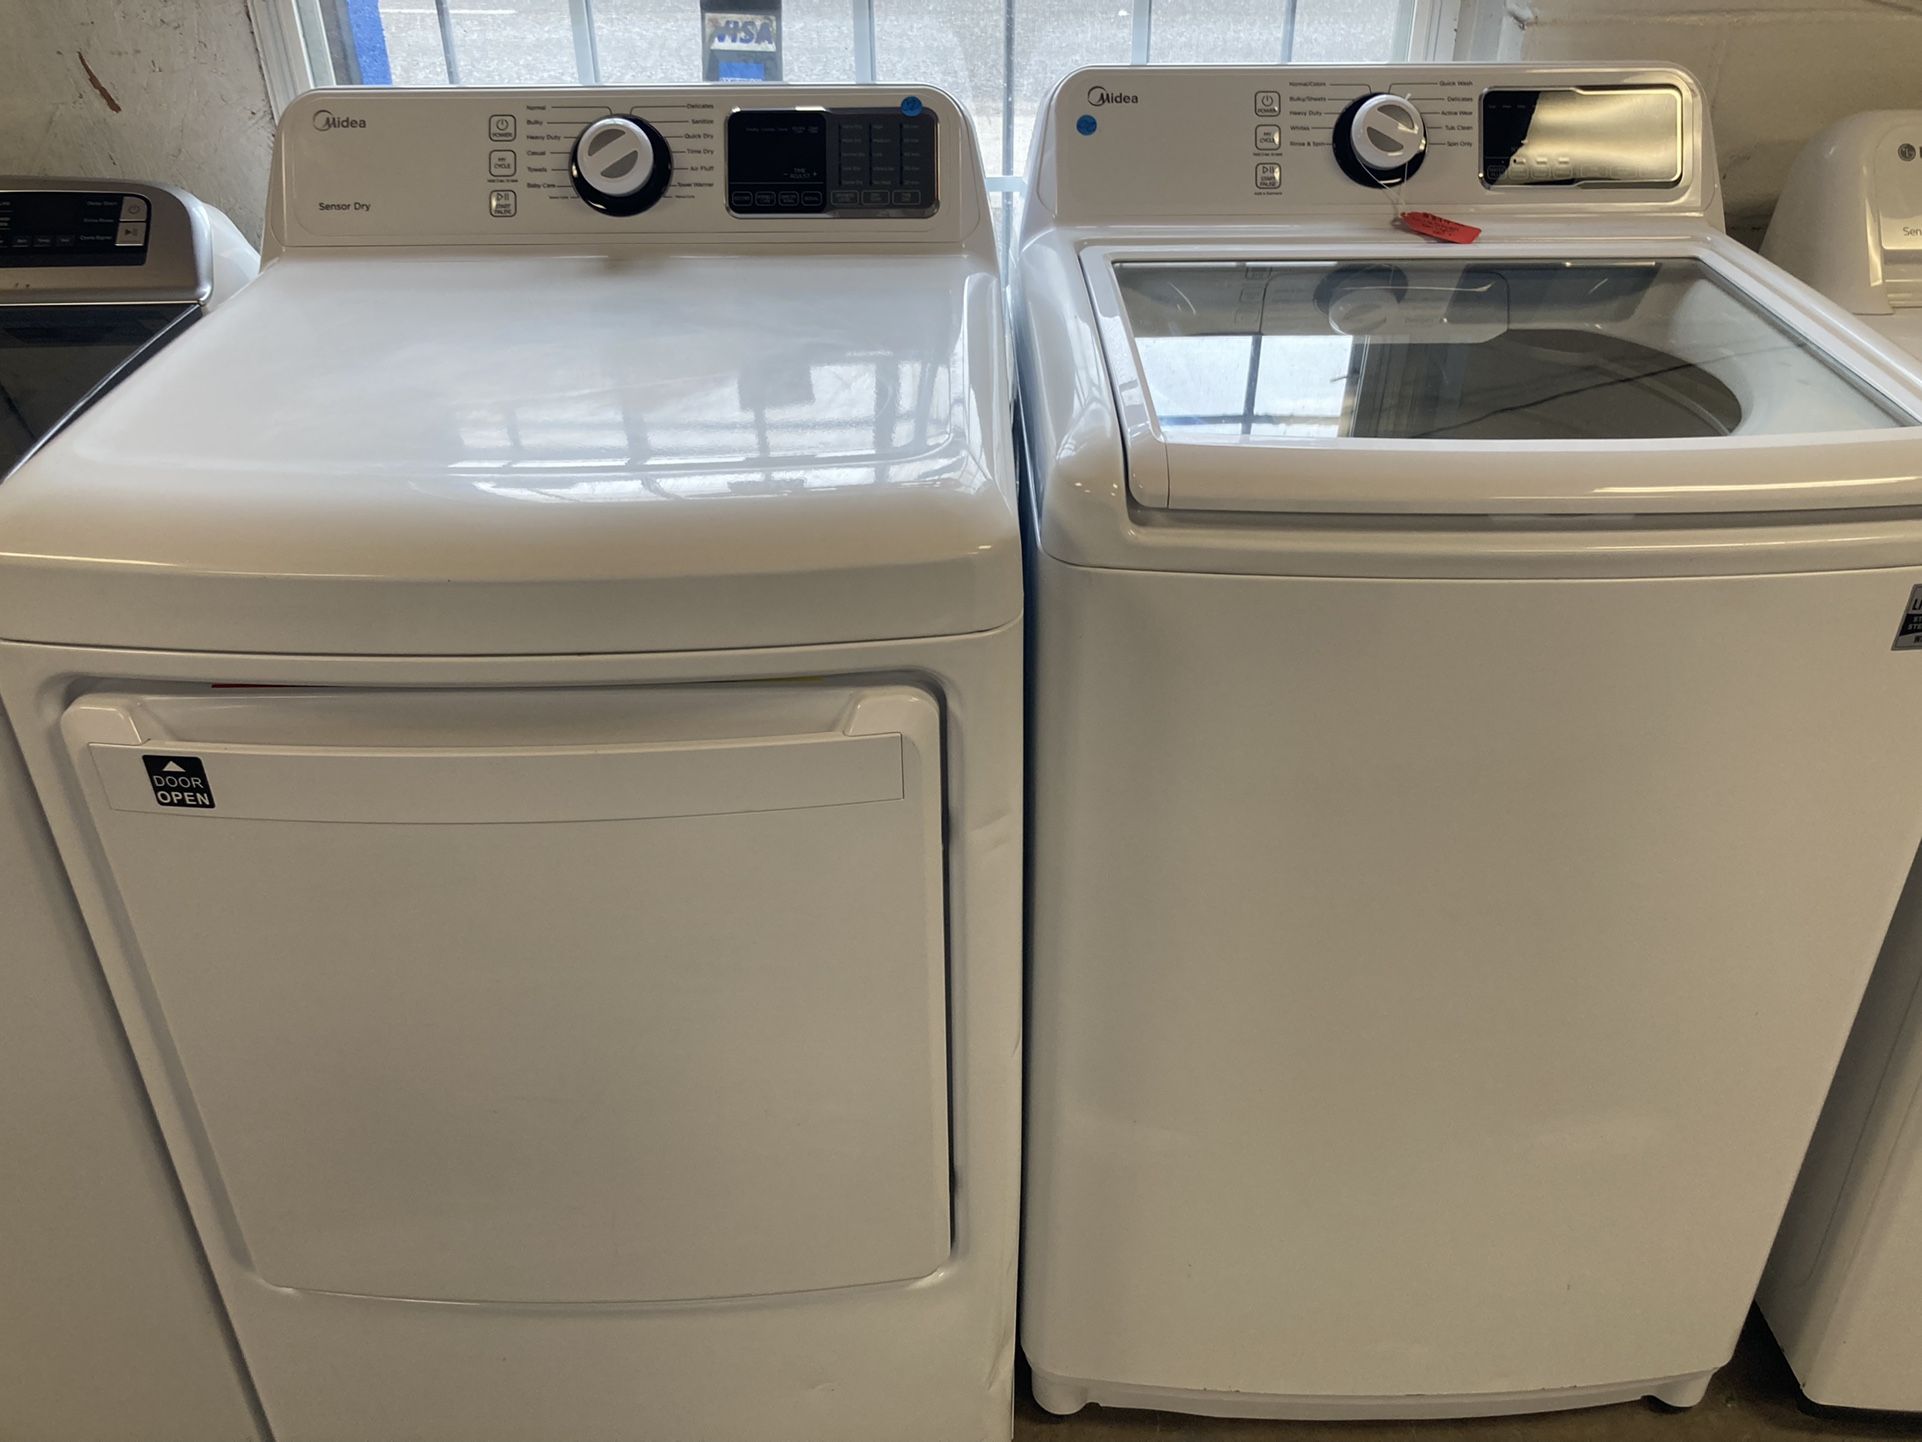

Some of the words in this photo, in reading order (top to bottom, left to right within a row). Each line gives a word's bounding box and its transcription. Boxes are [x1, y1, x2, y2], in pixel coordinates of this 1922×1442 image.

[1090, 88, 1138, 105] Midea
[315, 113, 367, 130] Midea
[319, 202, 351, 211] Sensor
[354, 202, 371, 212] Dry
[153, 775, 204, 788] DOOR
[157, 790, 209, 805] OPEN
